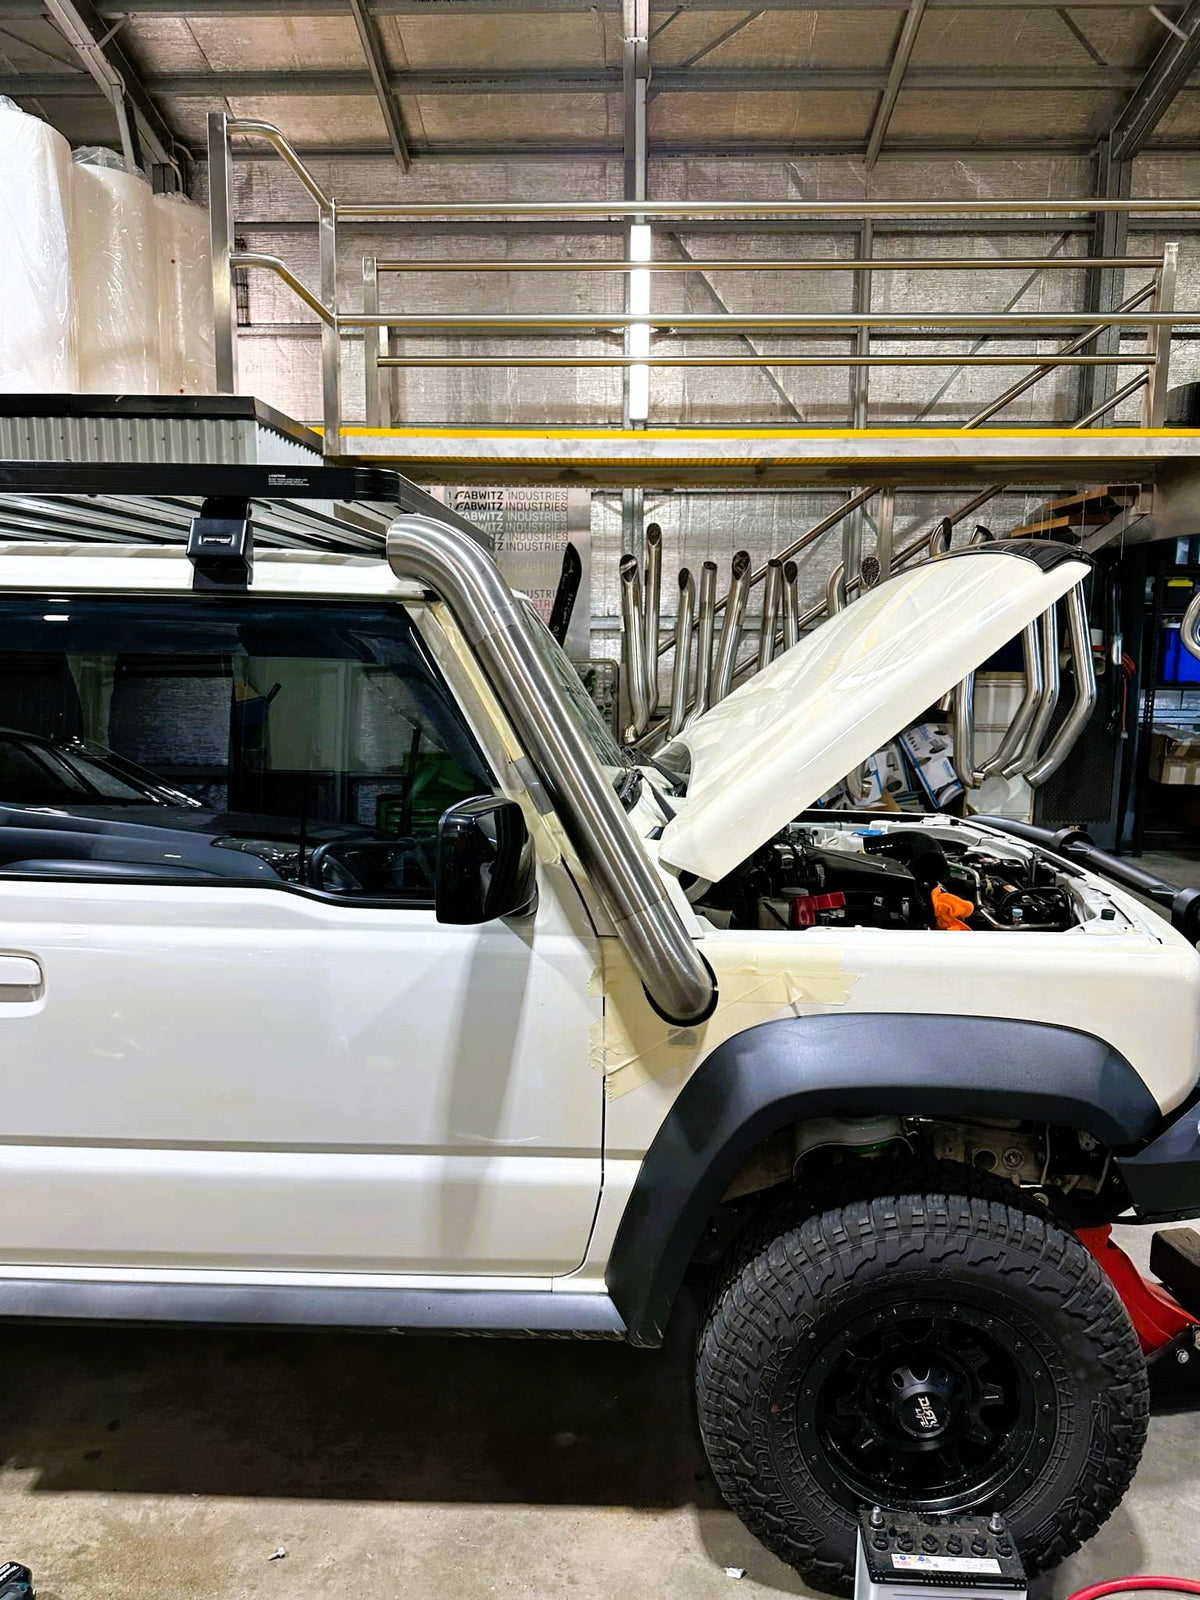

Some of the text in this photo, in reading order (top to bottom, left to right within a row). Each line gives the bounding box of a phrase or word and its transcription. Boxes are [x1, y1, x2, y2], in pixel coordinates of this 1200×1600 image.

[508, 491, 569, 501] INDUSTRIES
[505, 501, 568, 512] INDUSTRIES
[507, 511, 568, 522] INDUSTRIES
[505, 522, 568, 532] INDUSTRIES
[508, 532, 569, 541] INDUSTRIES
[506, 541, 568, 552] INDUSTRIES
